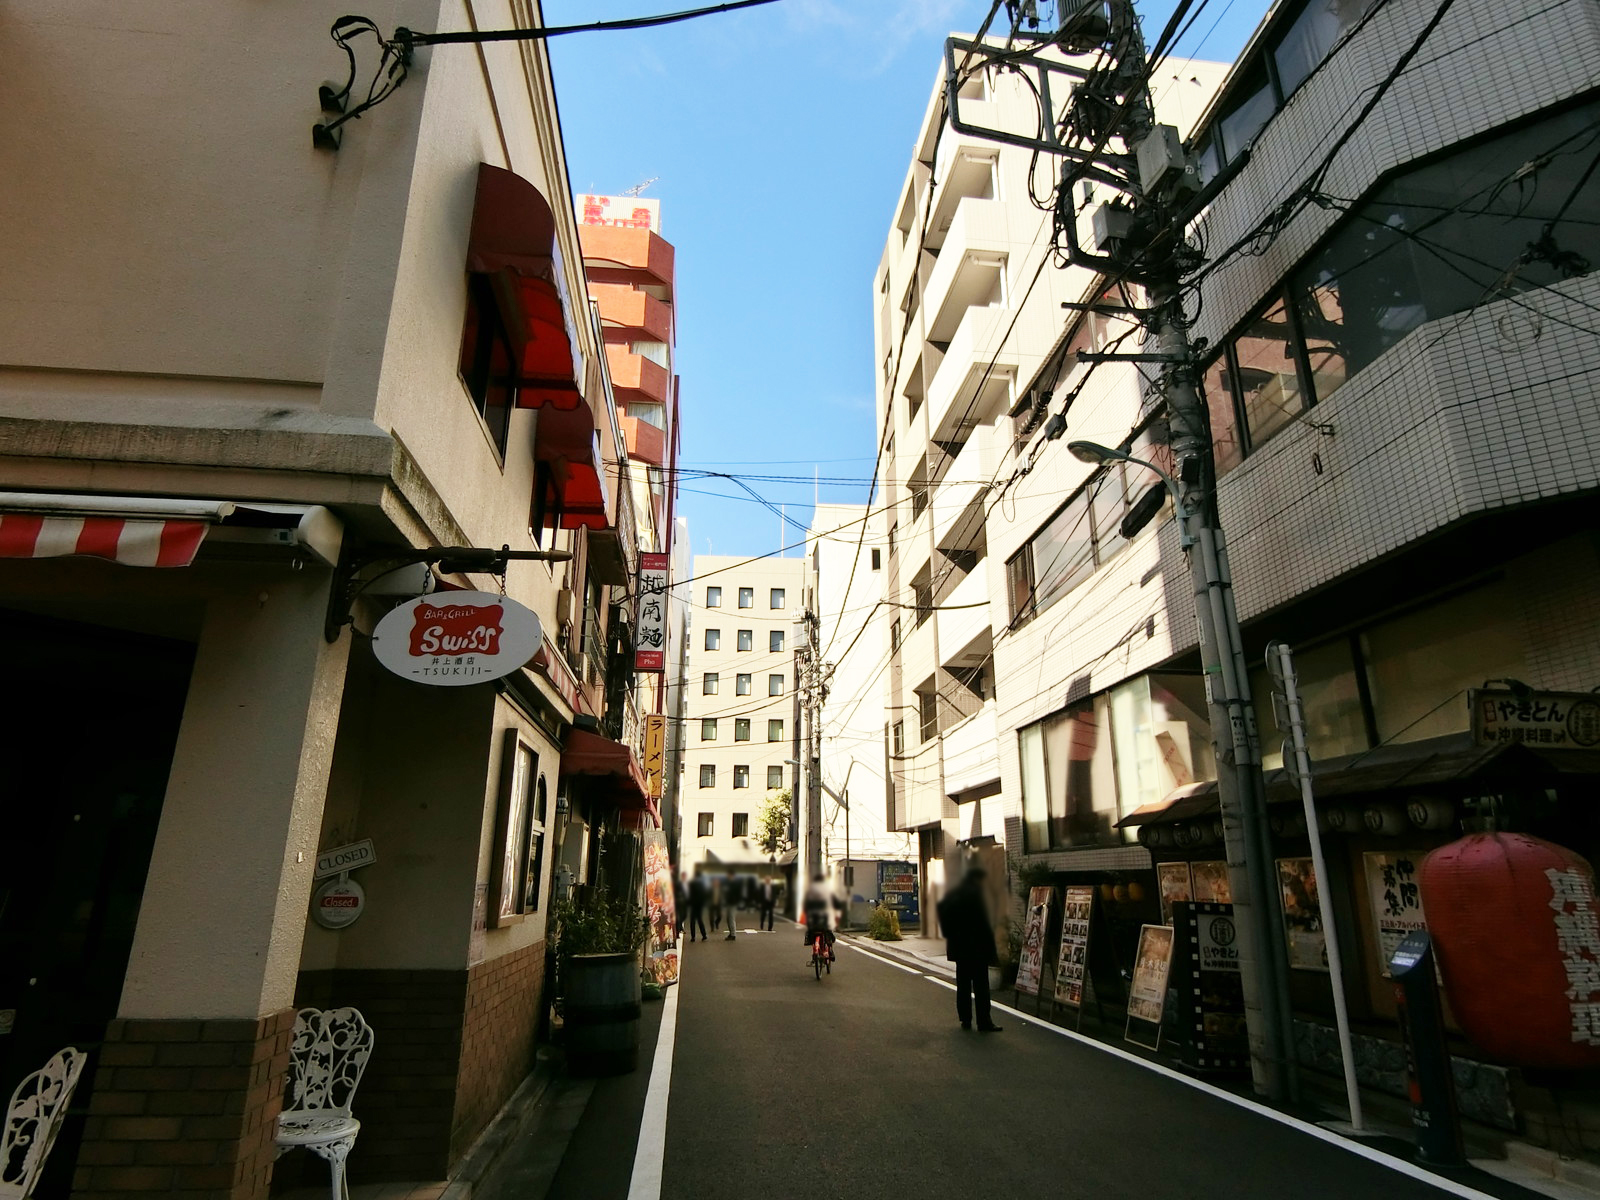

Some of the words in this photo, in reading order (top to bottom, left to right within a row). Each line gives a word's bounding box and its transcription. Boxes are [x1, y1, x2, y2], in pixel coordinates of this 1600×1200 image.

[420, 625, 497, 652] Swiss
[432, 657, 475, 666] 井上酒店
[1498, 700, 1564, 723] やきとん
[1498, 727, 1552, 743] 沖縄料理
[646, 719, 663, 778] ラーメン
[318, 847, 369, 871] CLOSED
[1379, 863, 1404, 917] 募集
[1396, 856, 1419, 909] 仲間
[324, 897, 353, 907] Closed
